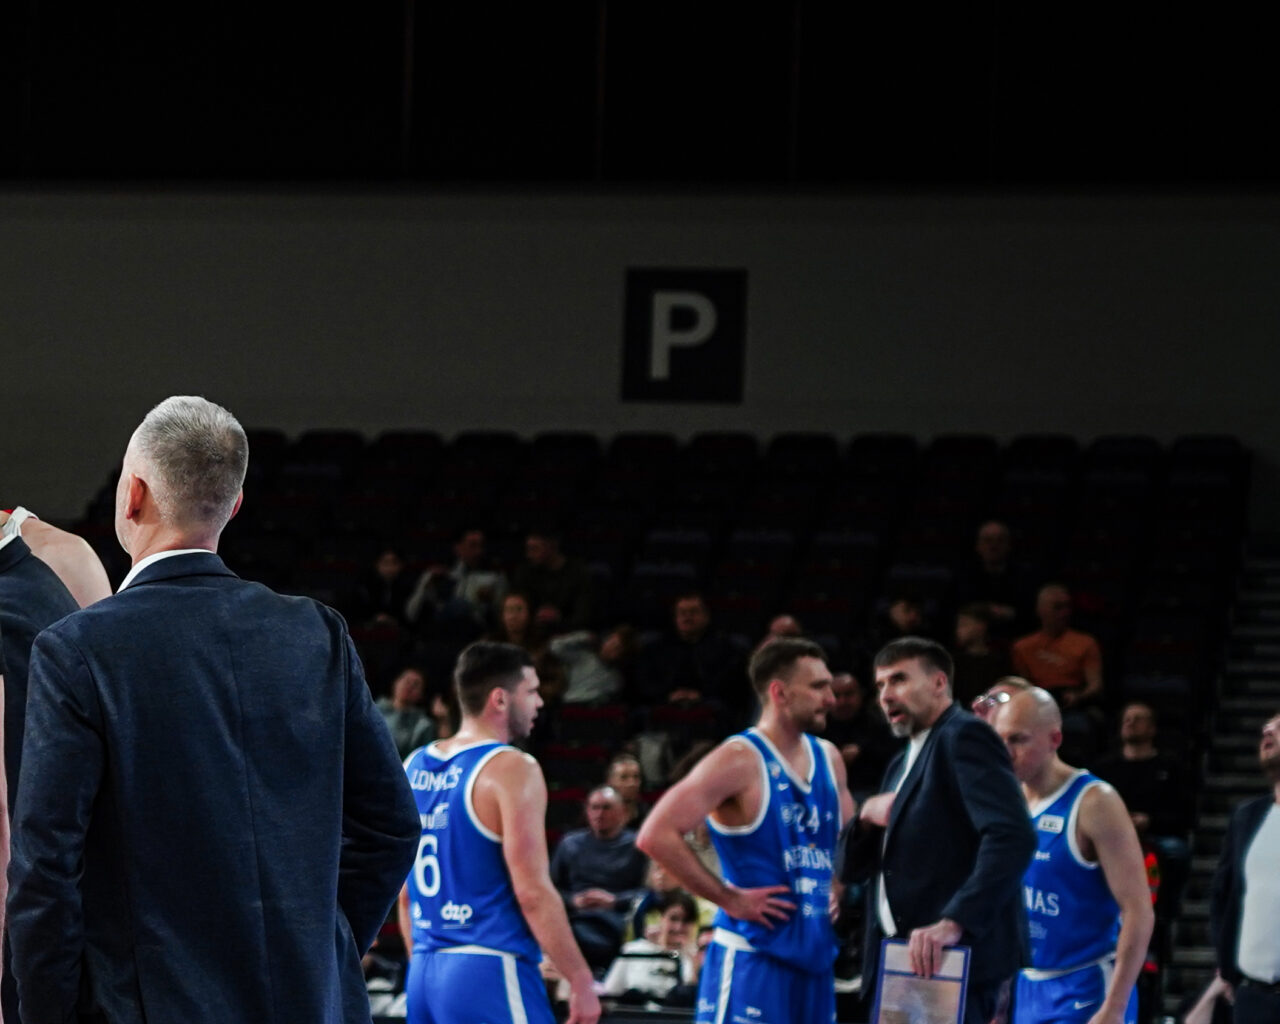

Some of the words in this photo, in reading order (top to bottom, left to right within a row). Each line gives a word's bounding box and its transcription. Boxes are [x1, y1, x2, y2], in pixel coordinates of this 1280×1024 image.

[651, 290, 717, 380] P
[414, 834, 441, 897] 6
[440, 900, 473, 925] dzp
